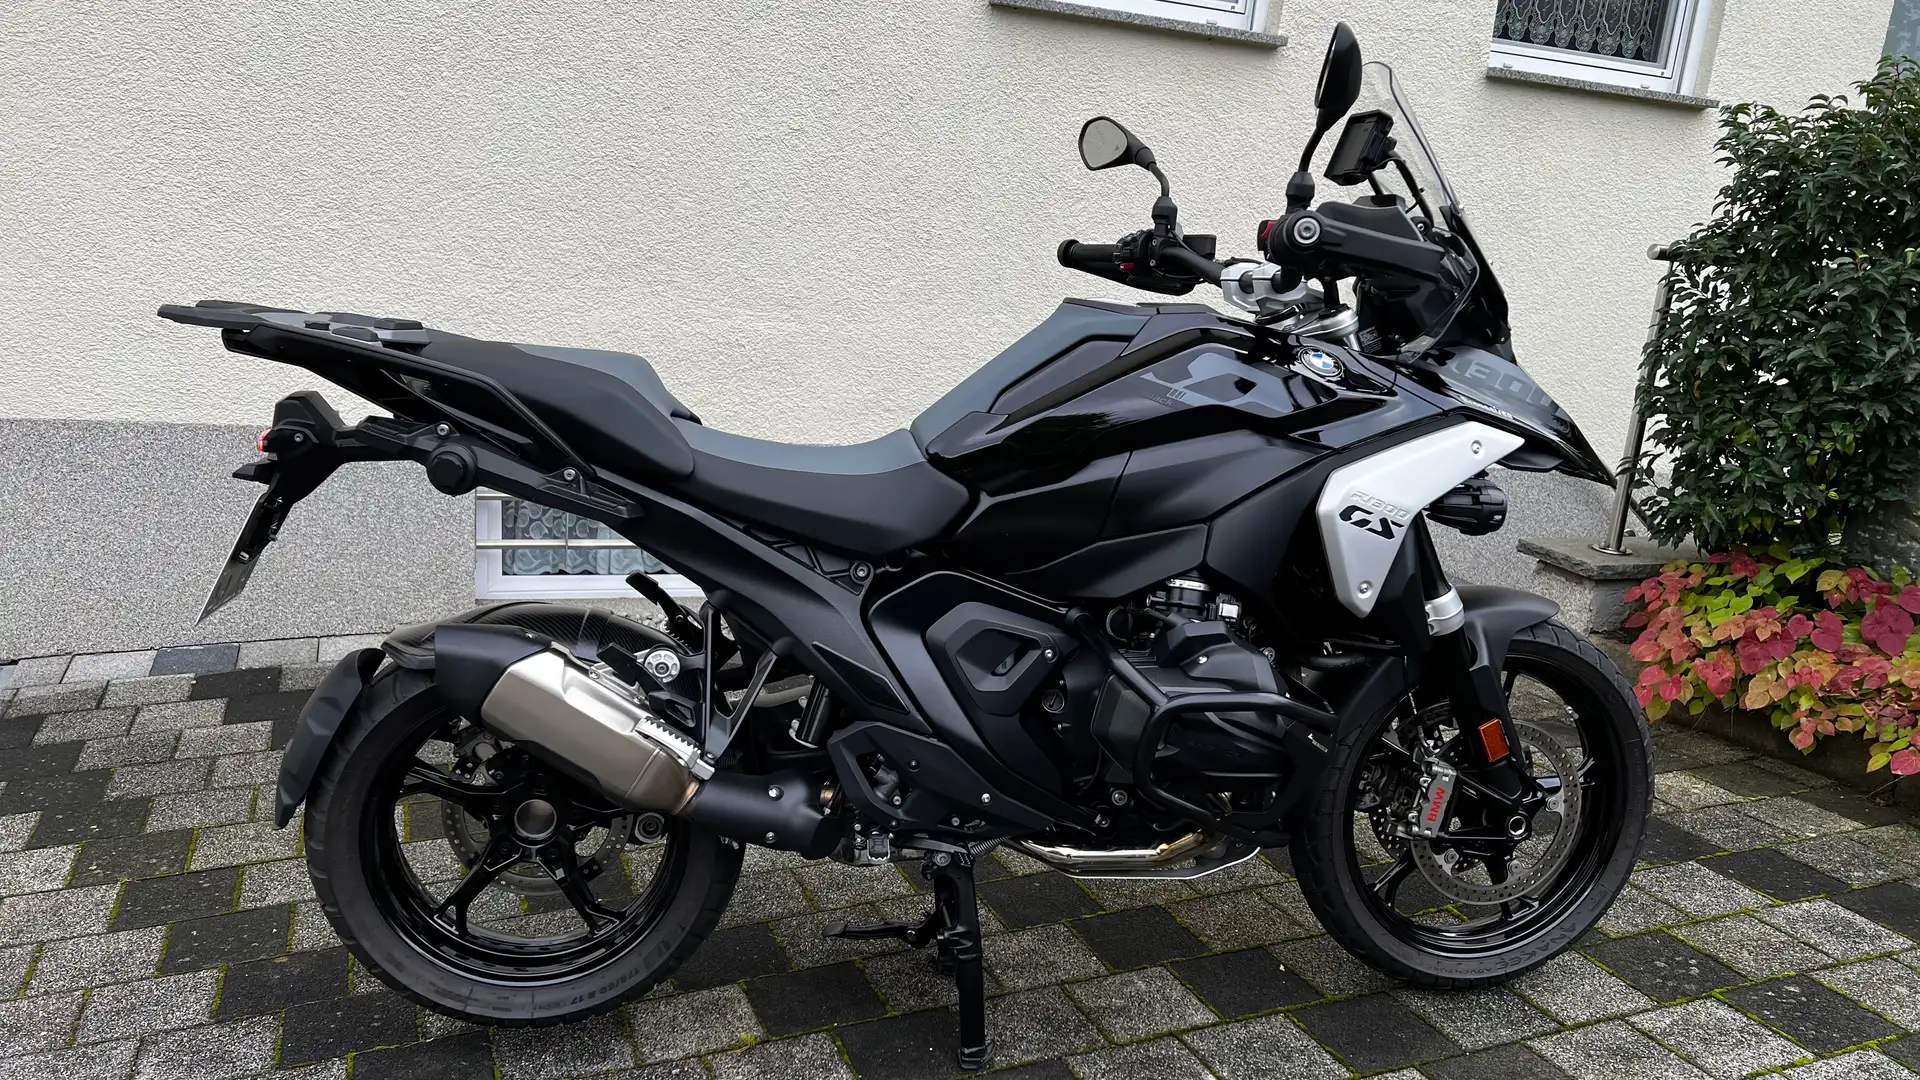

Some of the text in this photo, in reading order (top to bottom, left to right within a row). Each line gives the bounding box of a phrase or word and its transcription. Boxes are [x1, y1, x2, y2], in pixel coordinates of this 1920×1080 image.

[1339, 504, 1405, 540] GS
[1428, 785, 1447, 822] BMW
[1496, 922, 1576, 971] ANAKEE
